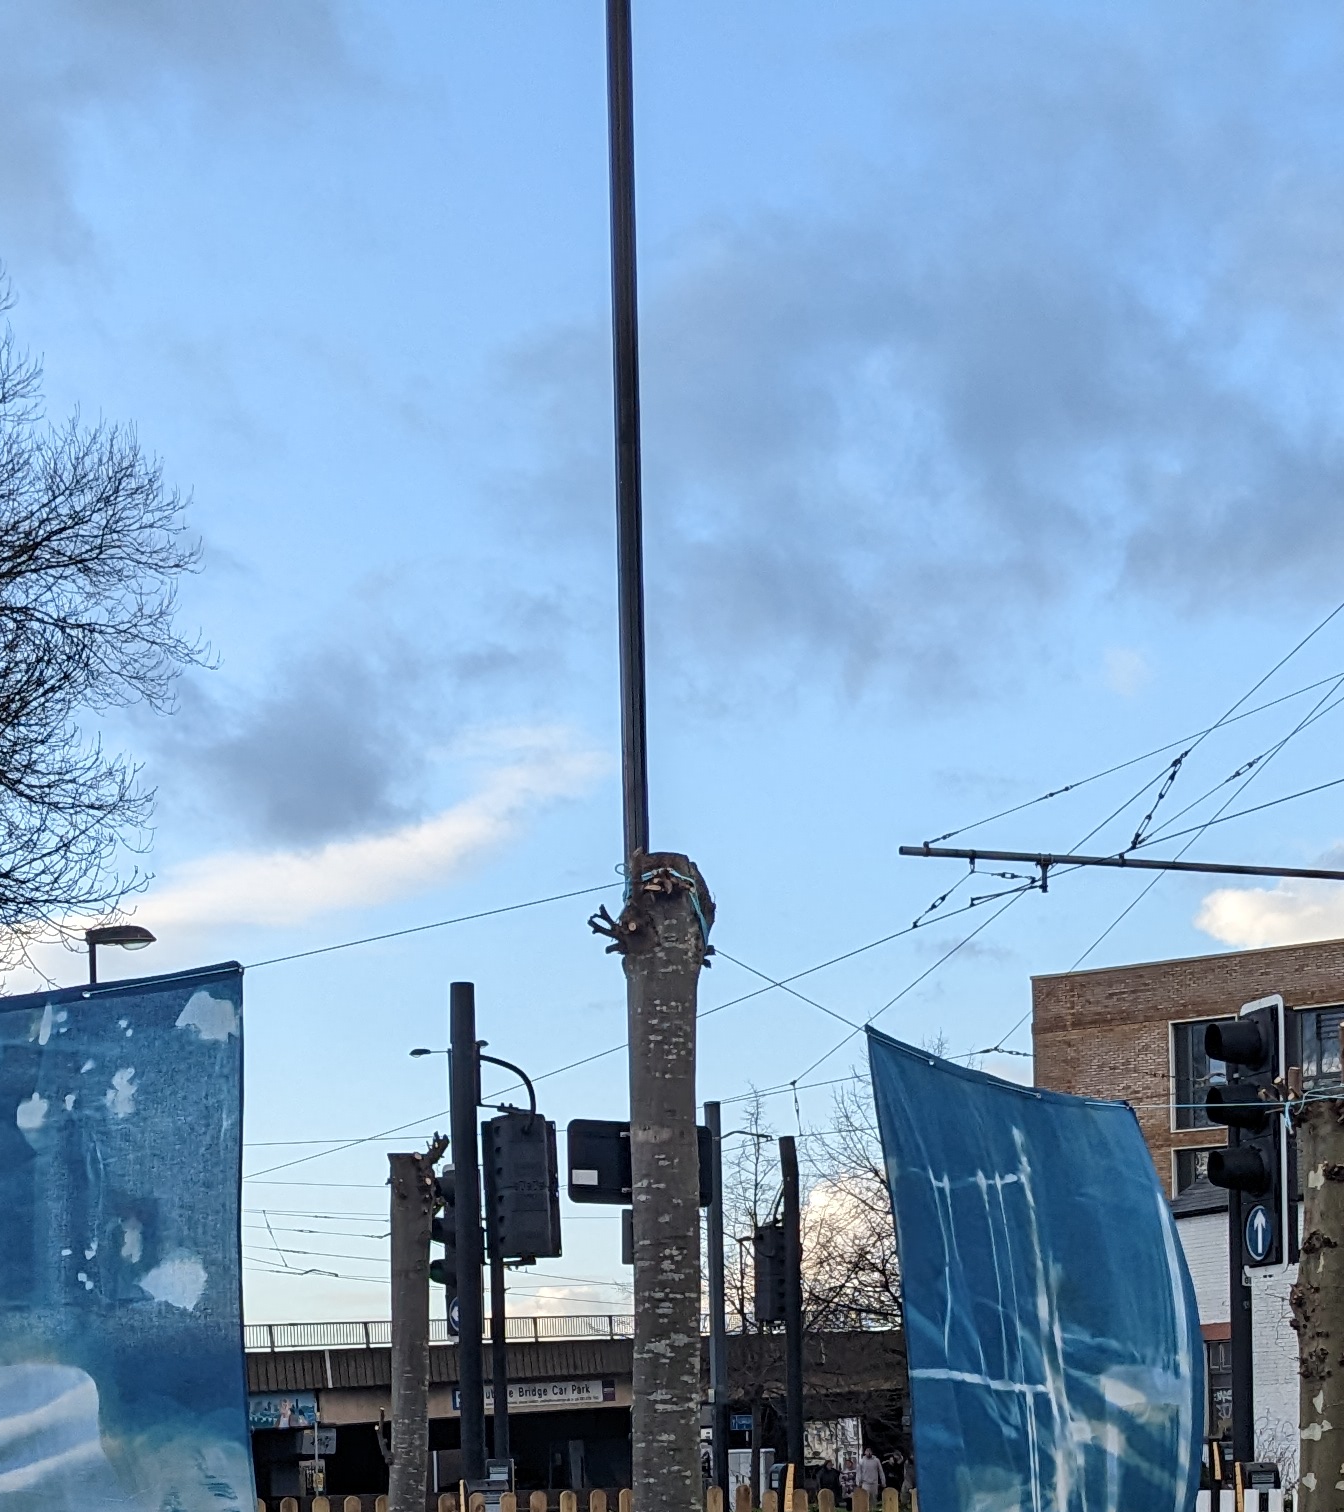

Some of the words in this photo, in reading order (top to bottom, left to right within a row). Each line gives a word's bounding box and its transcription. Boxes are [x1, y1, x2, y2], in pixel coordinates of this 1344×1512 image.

[518, 1386, 548, 1399] Bridge
[552, 1385, 567, 1396] Car
[571, 1384, 591, 1395] Park
